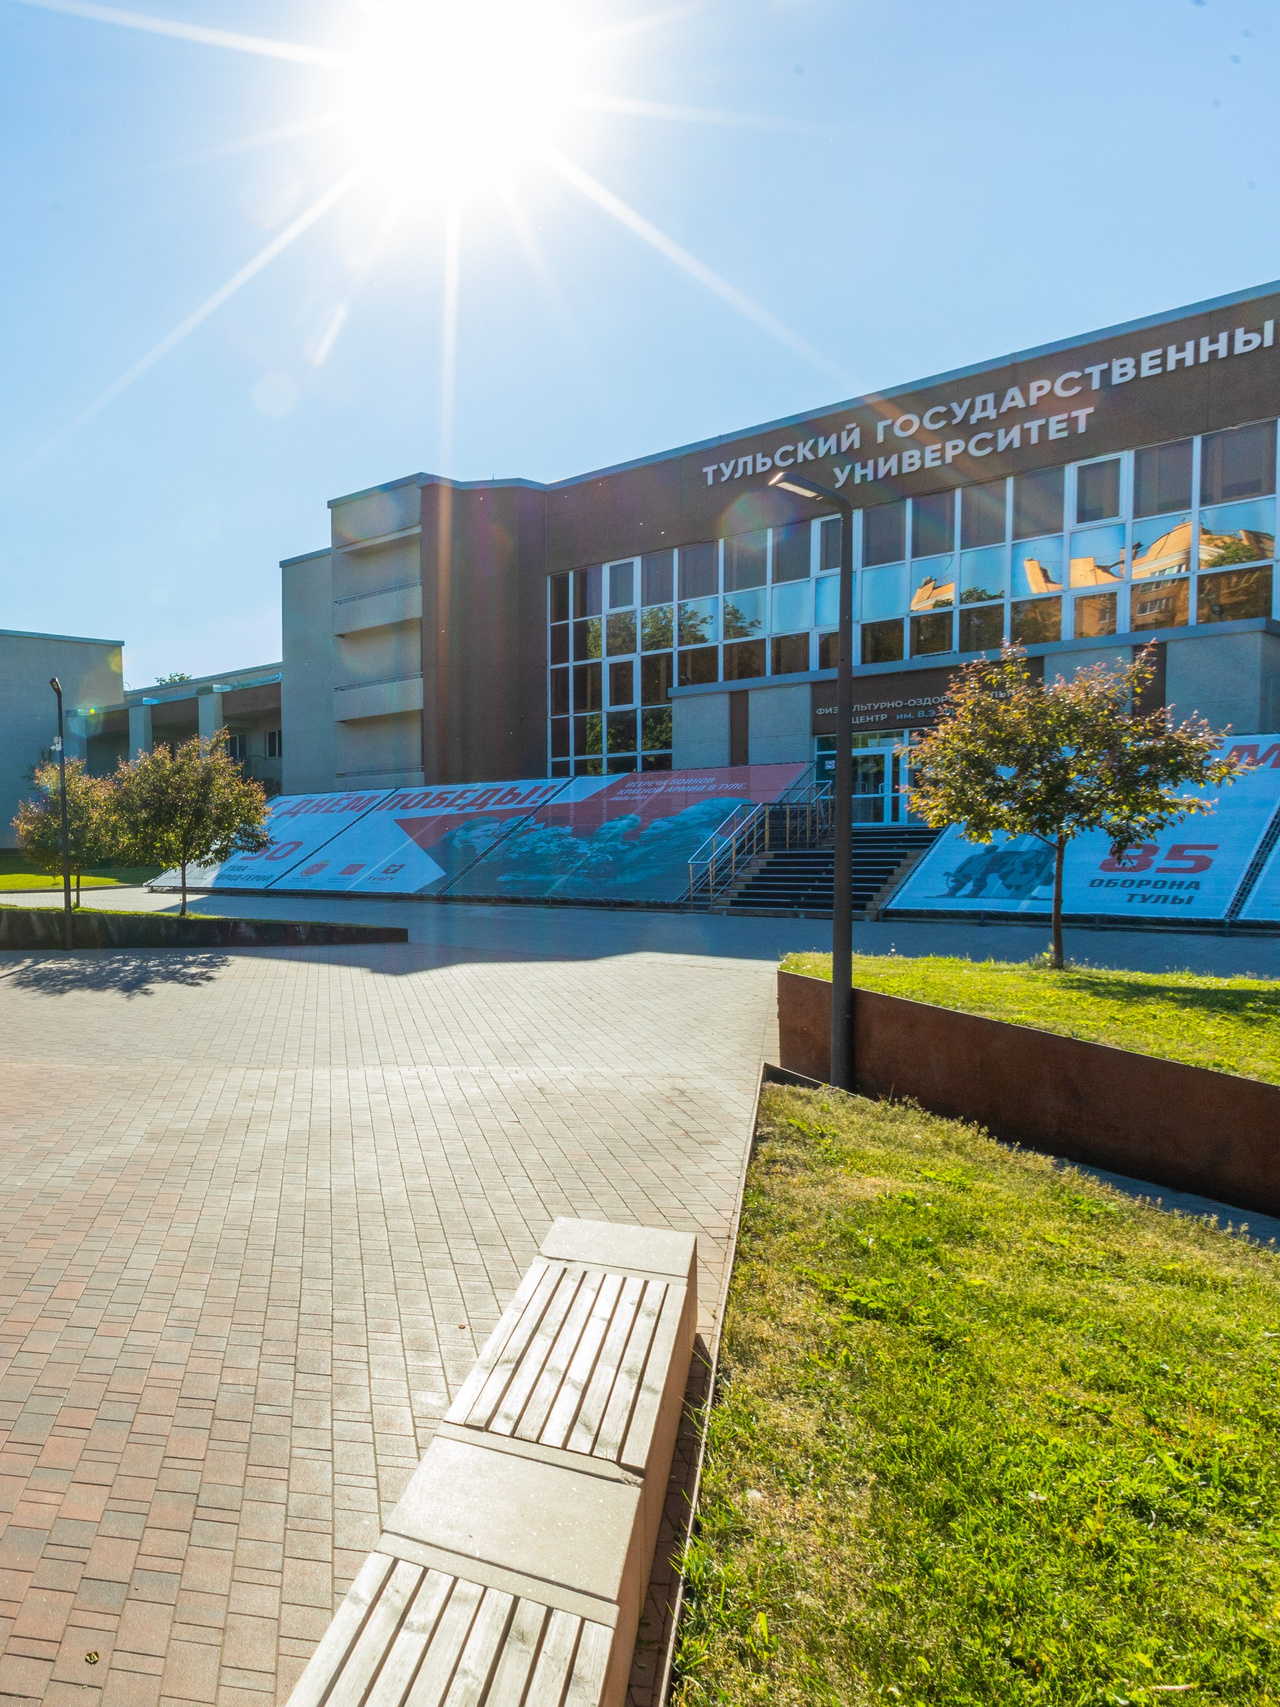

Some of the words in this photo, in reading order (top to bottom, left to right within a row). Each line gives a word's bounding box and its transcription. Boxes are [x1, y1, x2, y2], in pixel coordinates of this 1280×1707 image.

[702, 421, 861, 487] ТУЛЬСКИЙ
[877, 319, 1275, 444] ГОСУДАРСТВЕННЫ
[833, 407, 1095, 488] УНИВЕРСИТЕТ
[851, 713, 888, 724] ЦЕНТР
[896, 711, 915, 720] им.
[616, 785, 666, 795] КРАСНОЙ
[664, 785, 705, 793] АРМИИ
[706, 783, 716, 791] В
[625, 779, 668, 788] ВСТРЕЧА
[669, 777, 715, 785] ВОИНОВ
[276, 792, 380, 819] ДНЁМ
[376, 784, 559, 811] ПОБЕДЫ!
[1098, 843, 1220, 874] 85
[1088, 877, 1201, 890] ОБОРОНА
[1126, 893, 1194, 905] ТУЛЫ
